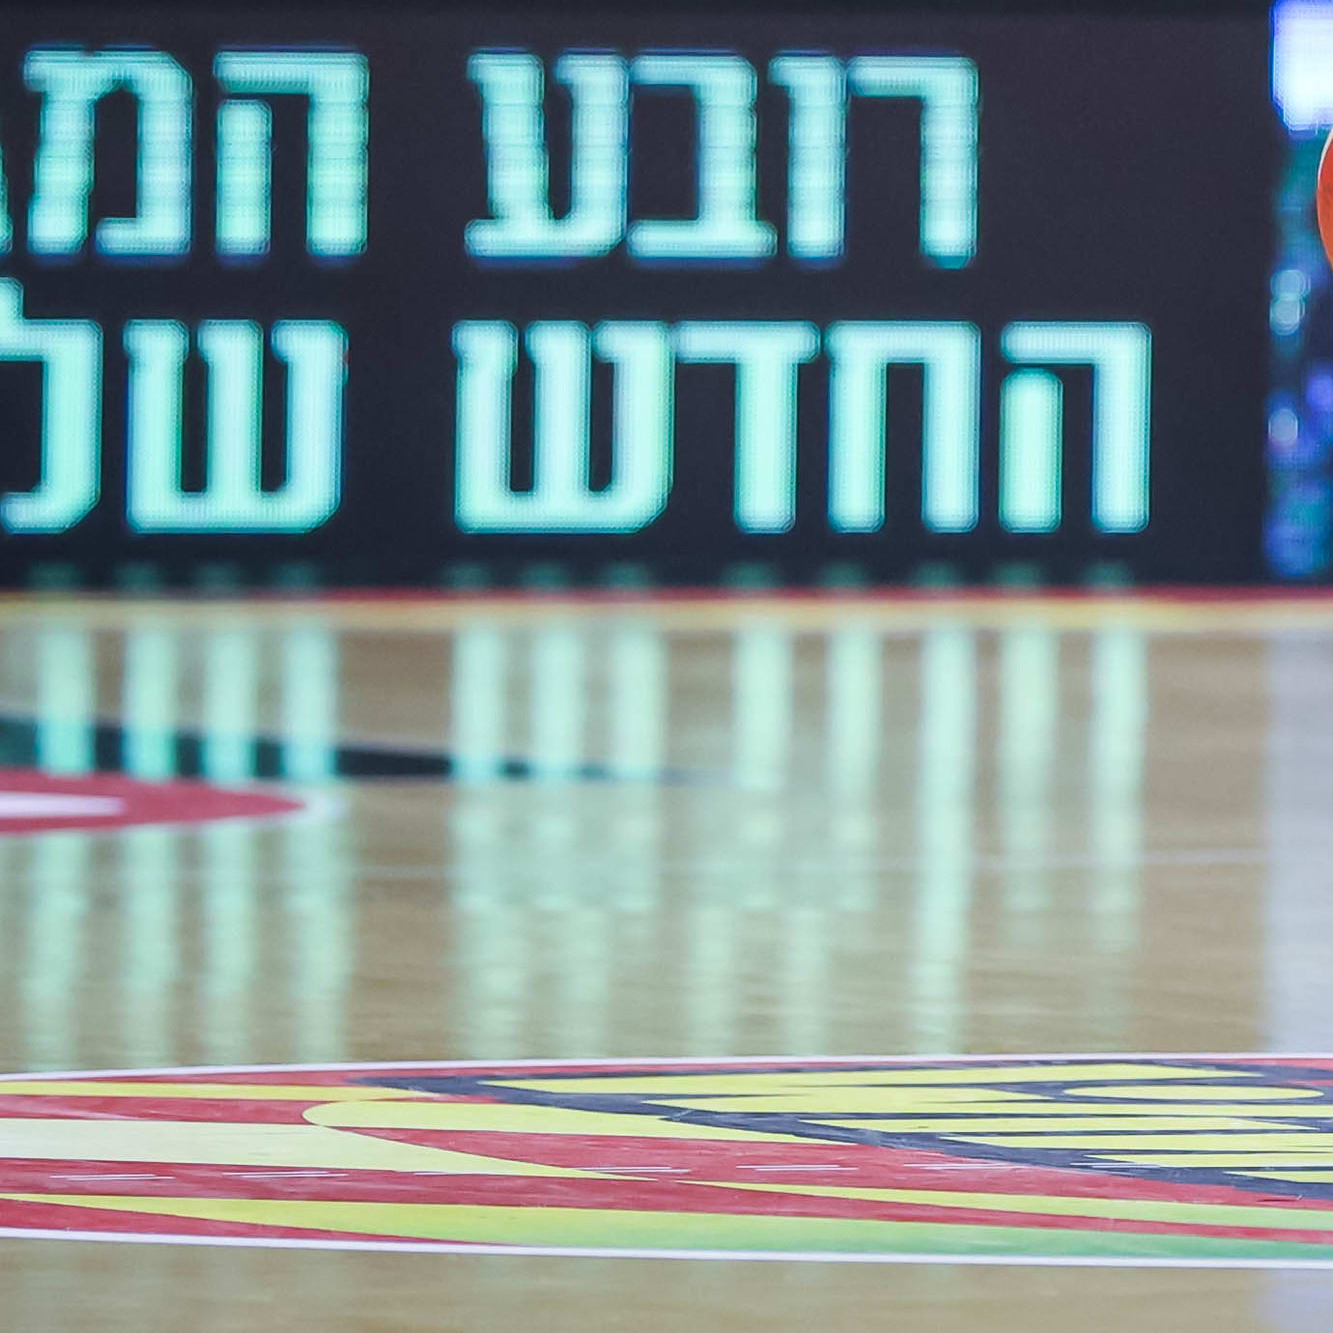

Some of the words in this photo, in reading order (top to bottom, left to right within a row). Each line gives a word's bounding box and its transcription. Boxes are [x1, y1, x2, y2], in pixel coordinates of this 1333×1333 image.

[0, 46, 372, 258] המ
[463, 46, 982, 266] רובע
[0, 275, 350, 534] של
[450, 318, 1154, 534] החדש
